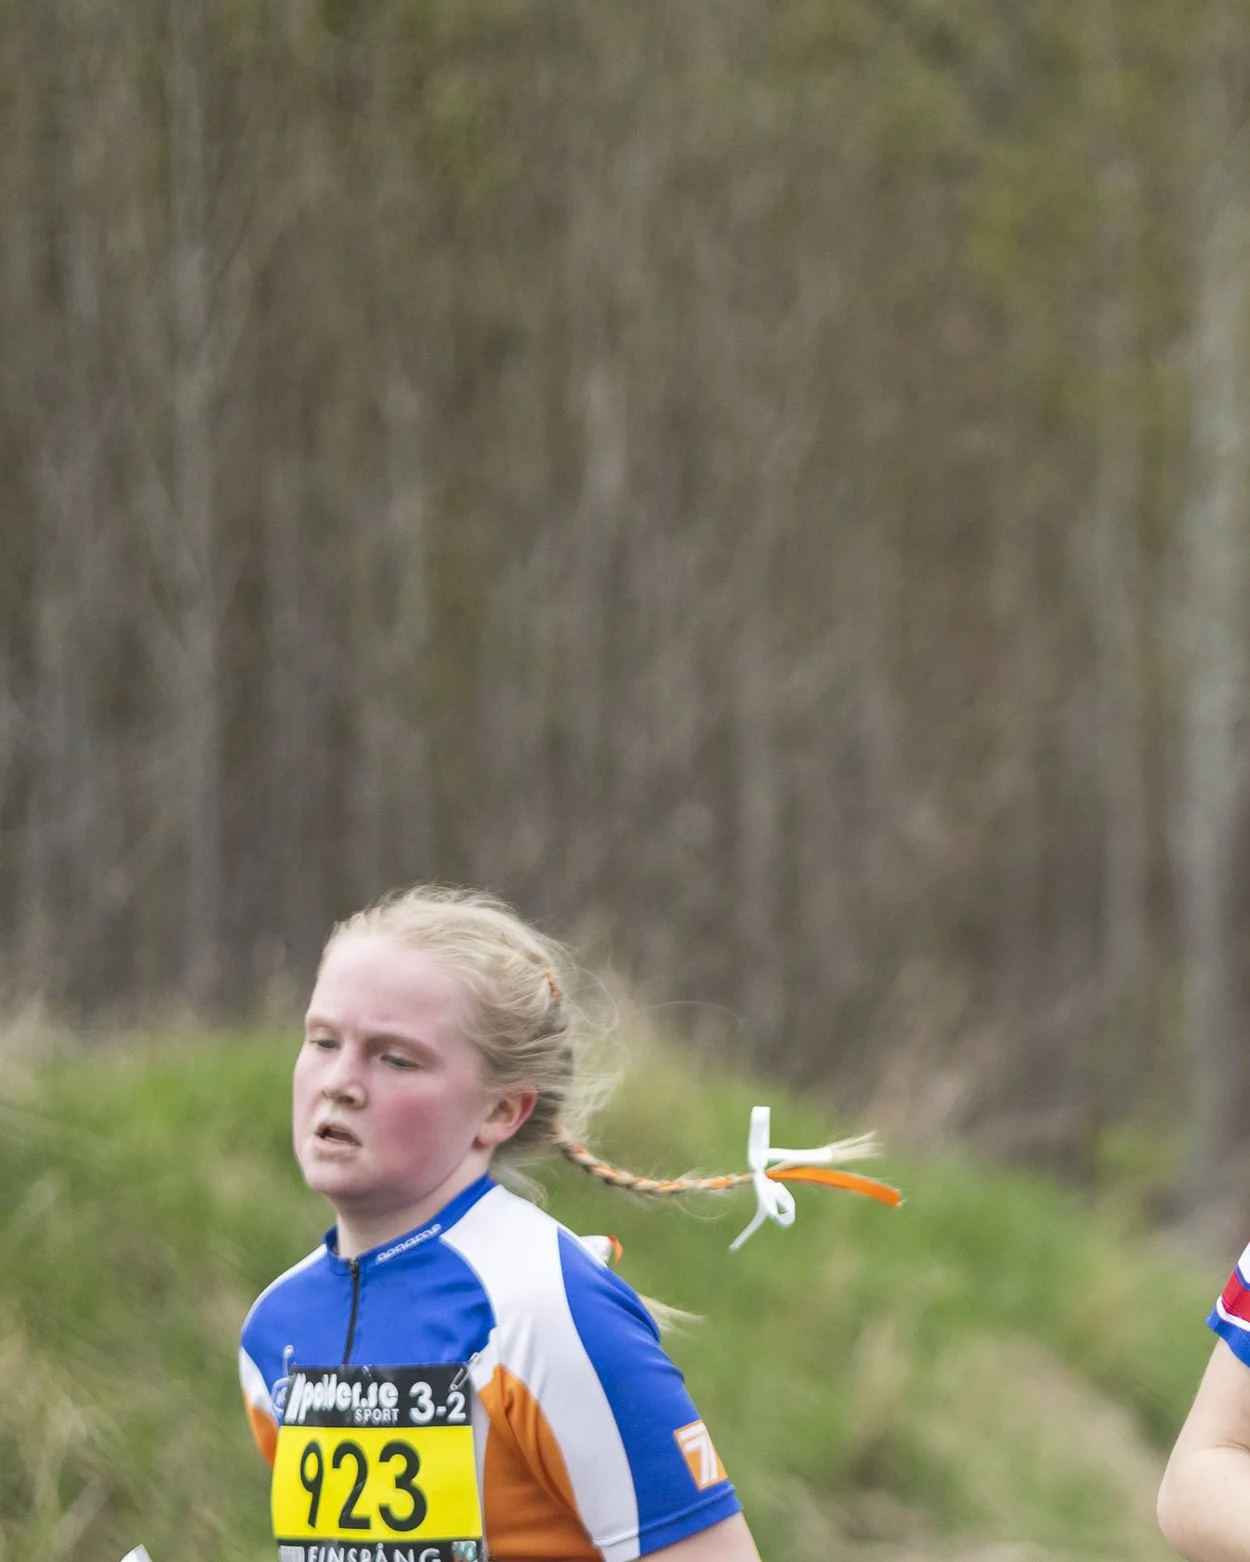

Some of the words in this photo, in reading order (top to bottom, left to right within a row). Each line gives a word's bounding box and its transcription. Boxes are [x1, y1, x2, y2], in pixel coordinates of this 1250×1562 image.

[354, 1407, 400, 1425] SPORT
[408, 1381, 467, 1424] 3-2
[300, 1439, 428, 1532] 923
